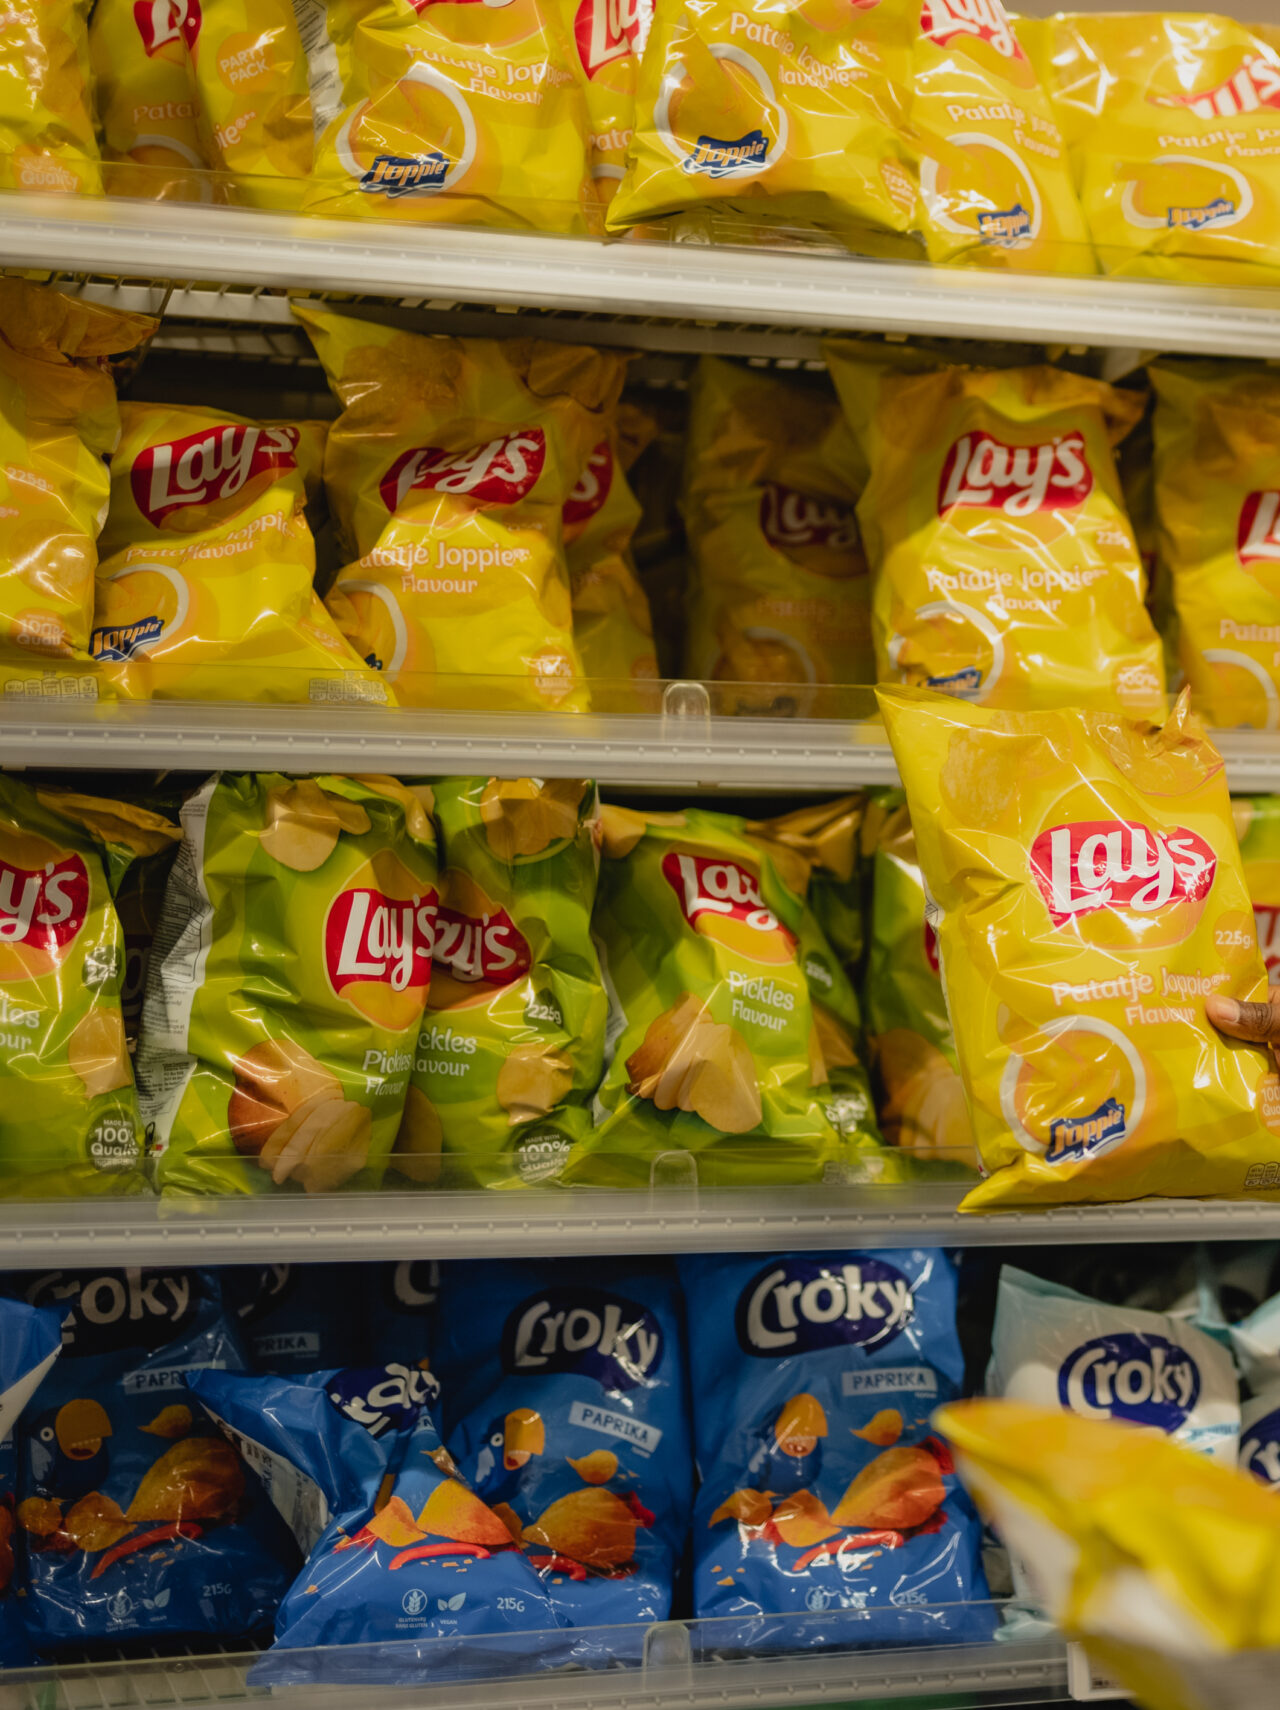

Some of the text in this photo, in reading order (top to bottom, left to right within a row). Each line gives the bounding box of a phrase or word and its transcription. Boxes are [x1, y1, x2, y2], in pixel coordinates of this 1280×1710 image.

[220, 47, 265, 73] PARTY
[229, 59, 270, 85] PACK
[133, 102, 193, 124] Pata
[695, 141, 765, 167] Joppie
[369, 157, 446, 185] Joppie
[940, 437, 1085, 517] Lay's
[762, 482, 859, 549] Lay
[360, 541, 515, 573] atatje Joppie
[401, 573, 479, 593] Flavour
[93, 622, 158, 655] Joppie
[1050, 827, 1206, 912] Lay's
[0, 862, 78, 942] y's
[336, 891, 438, 992] Lay's
[1215, 930, 1251, 949] 225g
[729, 969, 795, 1012] Pickles
[1052, 962, 1154, 1006] Patatje
[527, 1003, 562, 1024] 225g
[731, 999, 787, 1032] Flavour
[1125, 1004, 1196, 1025] Flavour
[417, 1026, 477, 1055] ckles
[361, 1049, 412, 1075] Pickles
[411, 1056, 470, 1077] lavour
[1049, 1108, 1123, 1158] Joppie
[518, 1139, 571, 1163] 100%
[746, 1264, 912, 1349] Croky
[256, 1334, 308, 1351] PRIKA
[515, 1301, 658, 1370] Croky
[135, 1369, 185, 1389] PAPR
[852, 1374, 926, 1389] PAPRIKA
[1067, 1347, 1194, 1420] Croky
[581, 1408, 649, 1445] PAPRIKA
[202, 1583, 233, 1598] 215G
[496, 1597, 526, 1613] 215G
